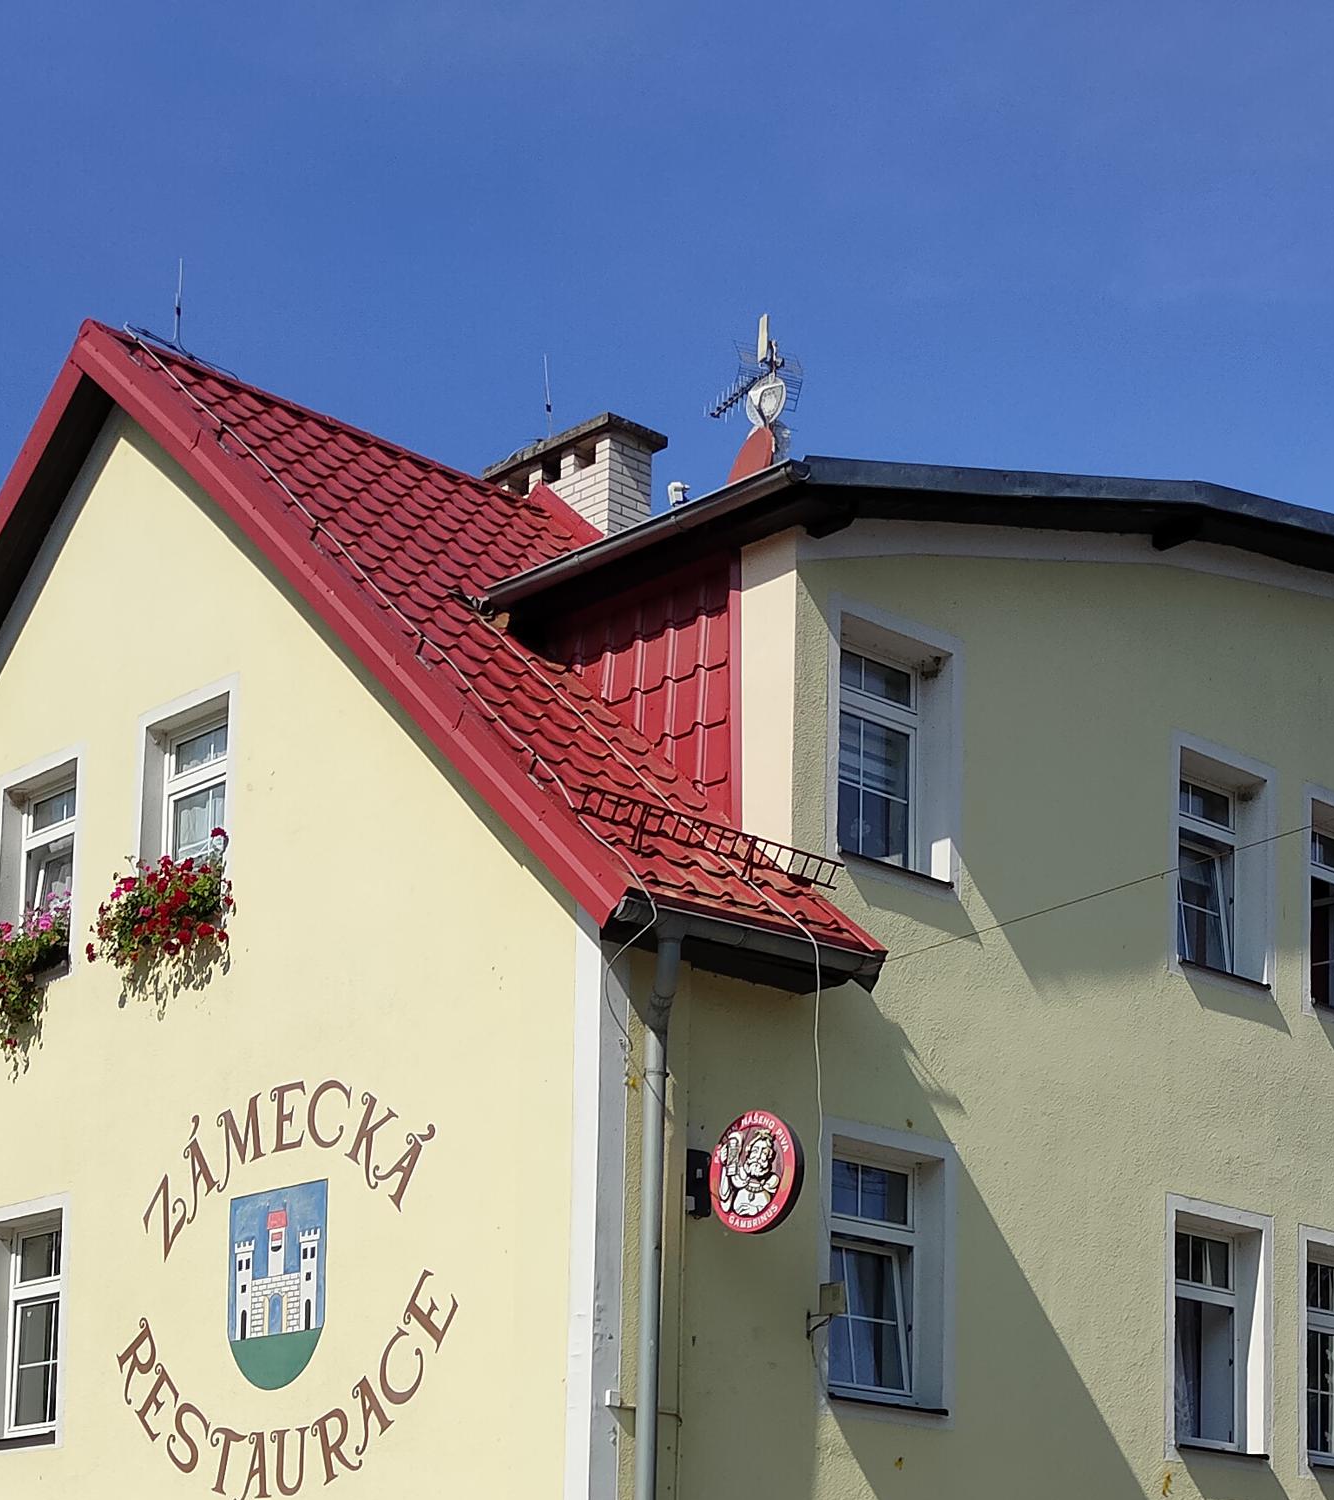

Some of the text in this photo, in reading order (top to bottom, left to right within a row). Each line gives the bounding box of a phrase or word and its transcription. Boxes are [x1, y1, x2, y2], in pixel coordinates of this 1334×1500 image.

[741, 1111, 776, 1129] NAŠEHO
[776, 1127, 790, 1153] PIVA
[142, 1079, 436, 1263] ZÁMECKÁ
[728, 1203, 779, 1229] GAMBRINUS
